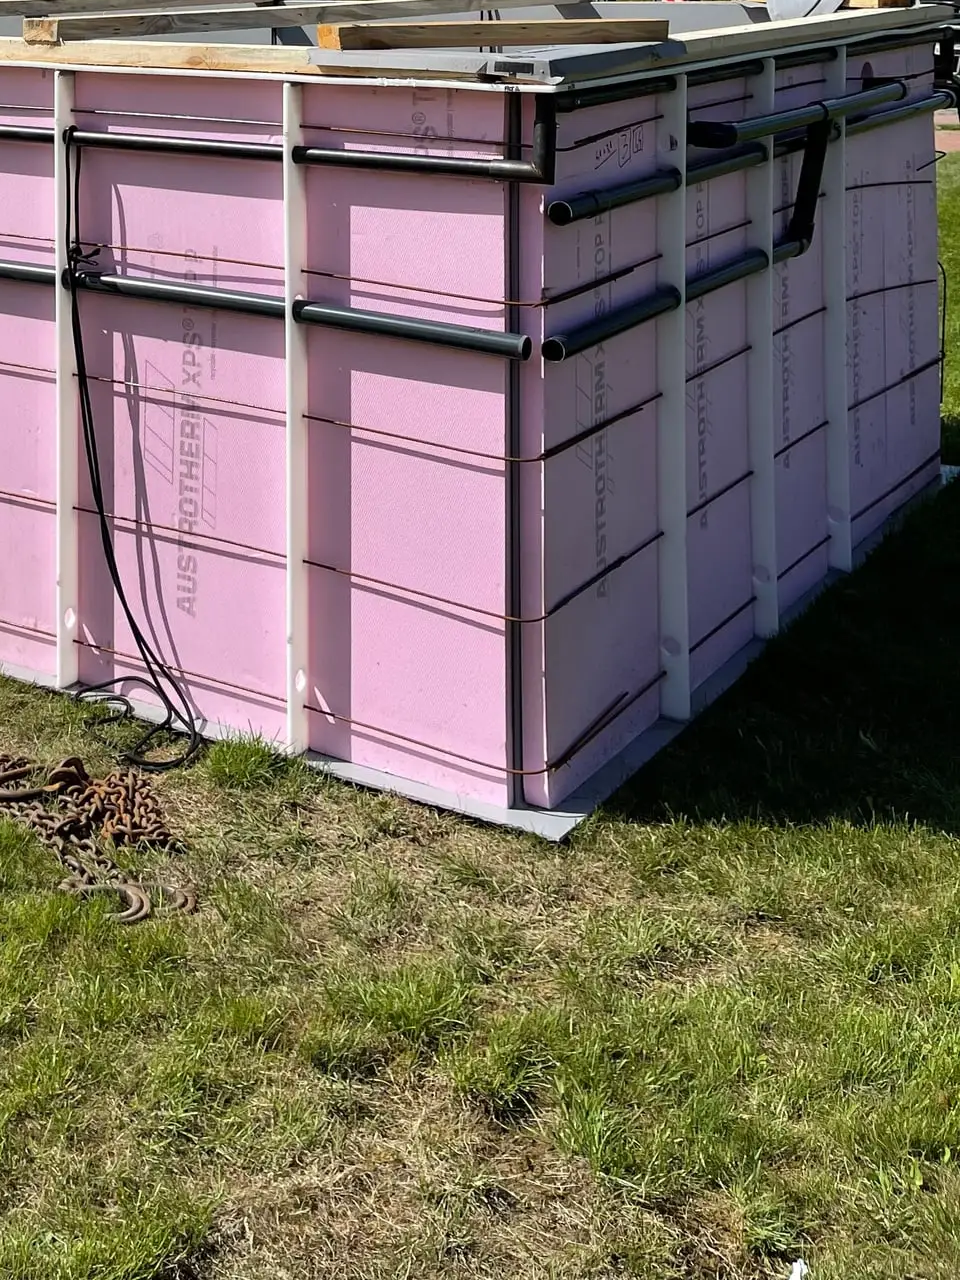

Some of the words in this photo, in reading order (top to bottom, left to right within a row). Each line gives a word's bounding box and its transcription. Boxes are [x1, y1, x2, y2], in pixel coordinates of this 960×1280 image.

[695, 200, 705, 239] TOP
[176, 392, 201, 618] AUSTROTHERM
[593, 359, 608, 599] AUSTROTHERM
